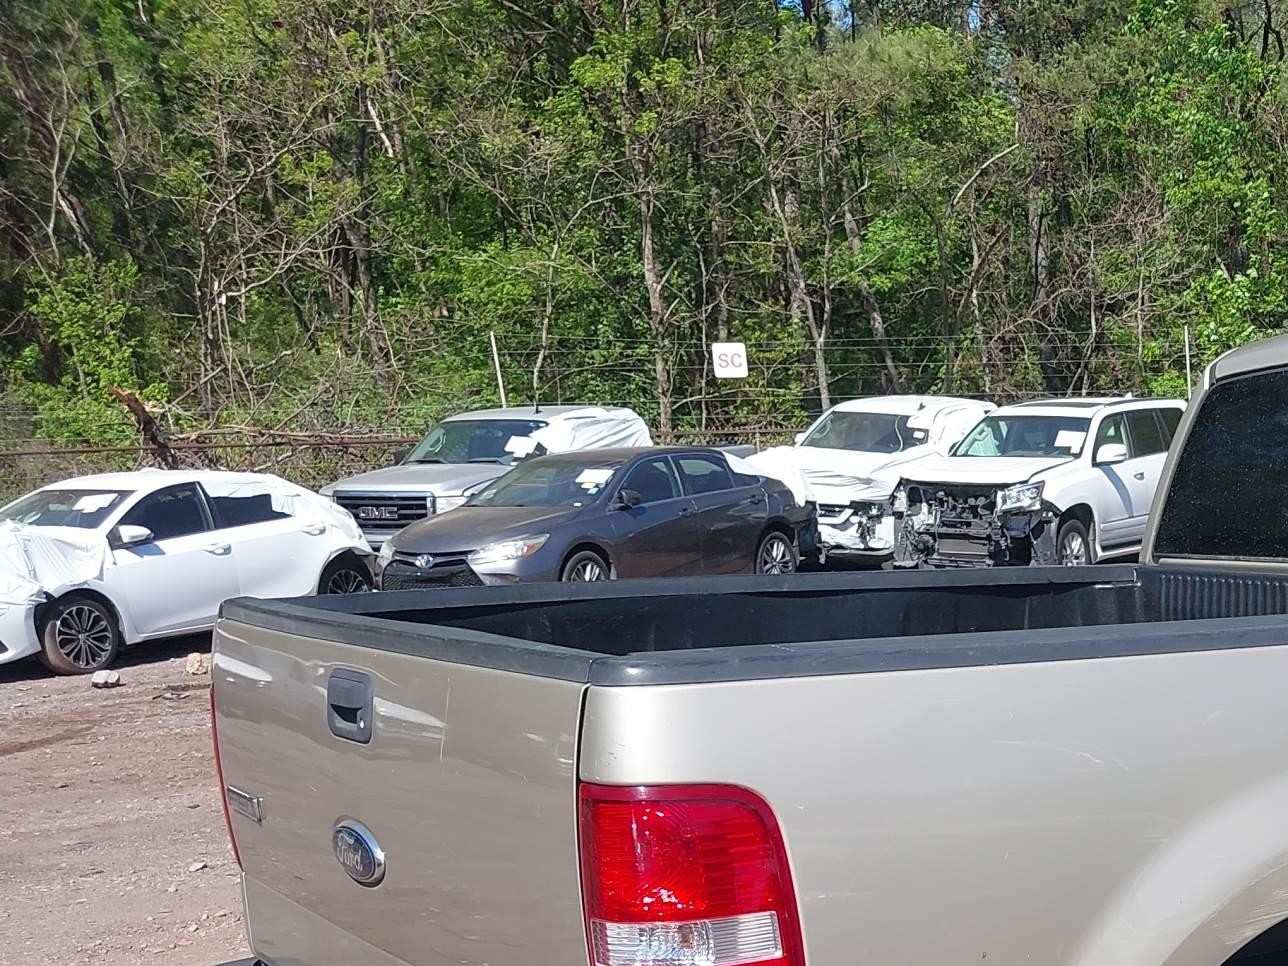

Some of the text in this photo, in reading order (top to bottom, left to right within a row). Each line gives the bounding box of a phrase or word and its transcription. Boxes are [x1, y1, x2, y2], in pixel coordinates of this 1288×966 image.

[718, 353, 743, 369] SC
[359, 506, 398, 519] GMC
[337, 832, 363, 871] Ford
